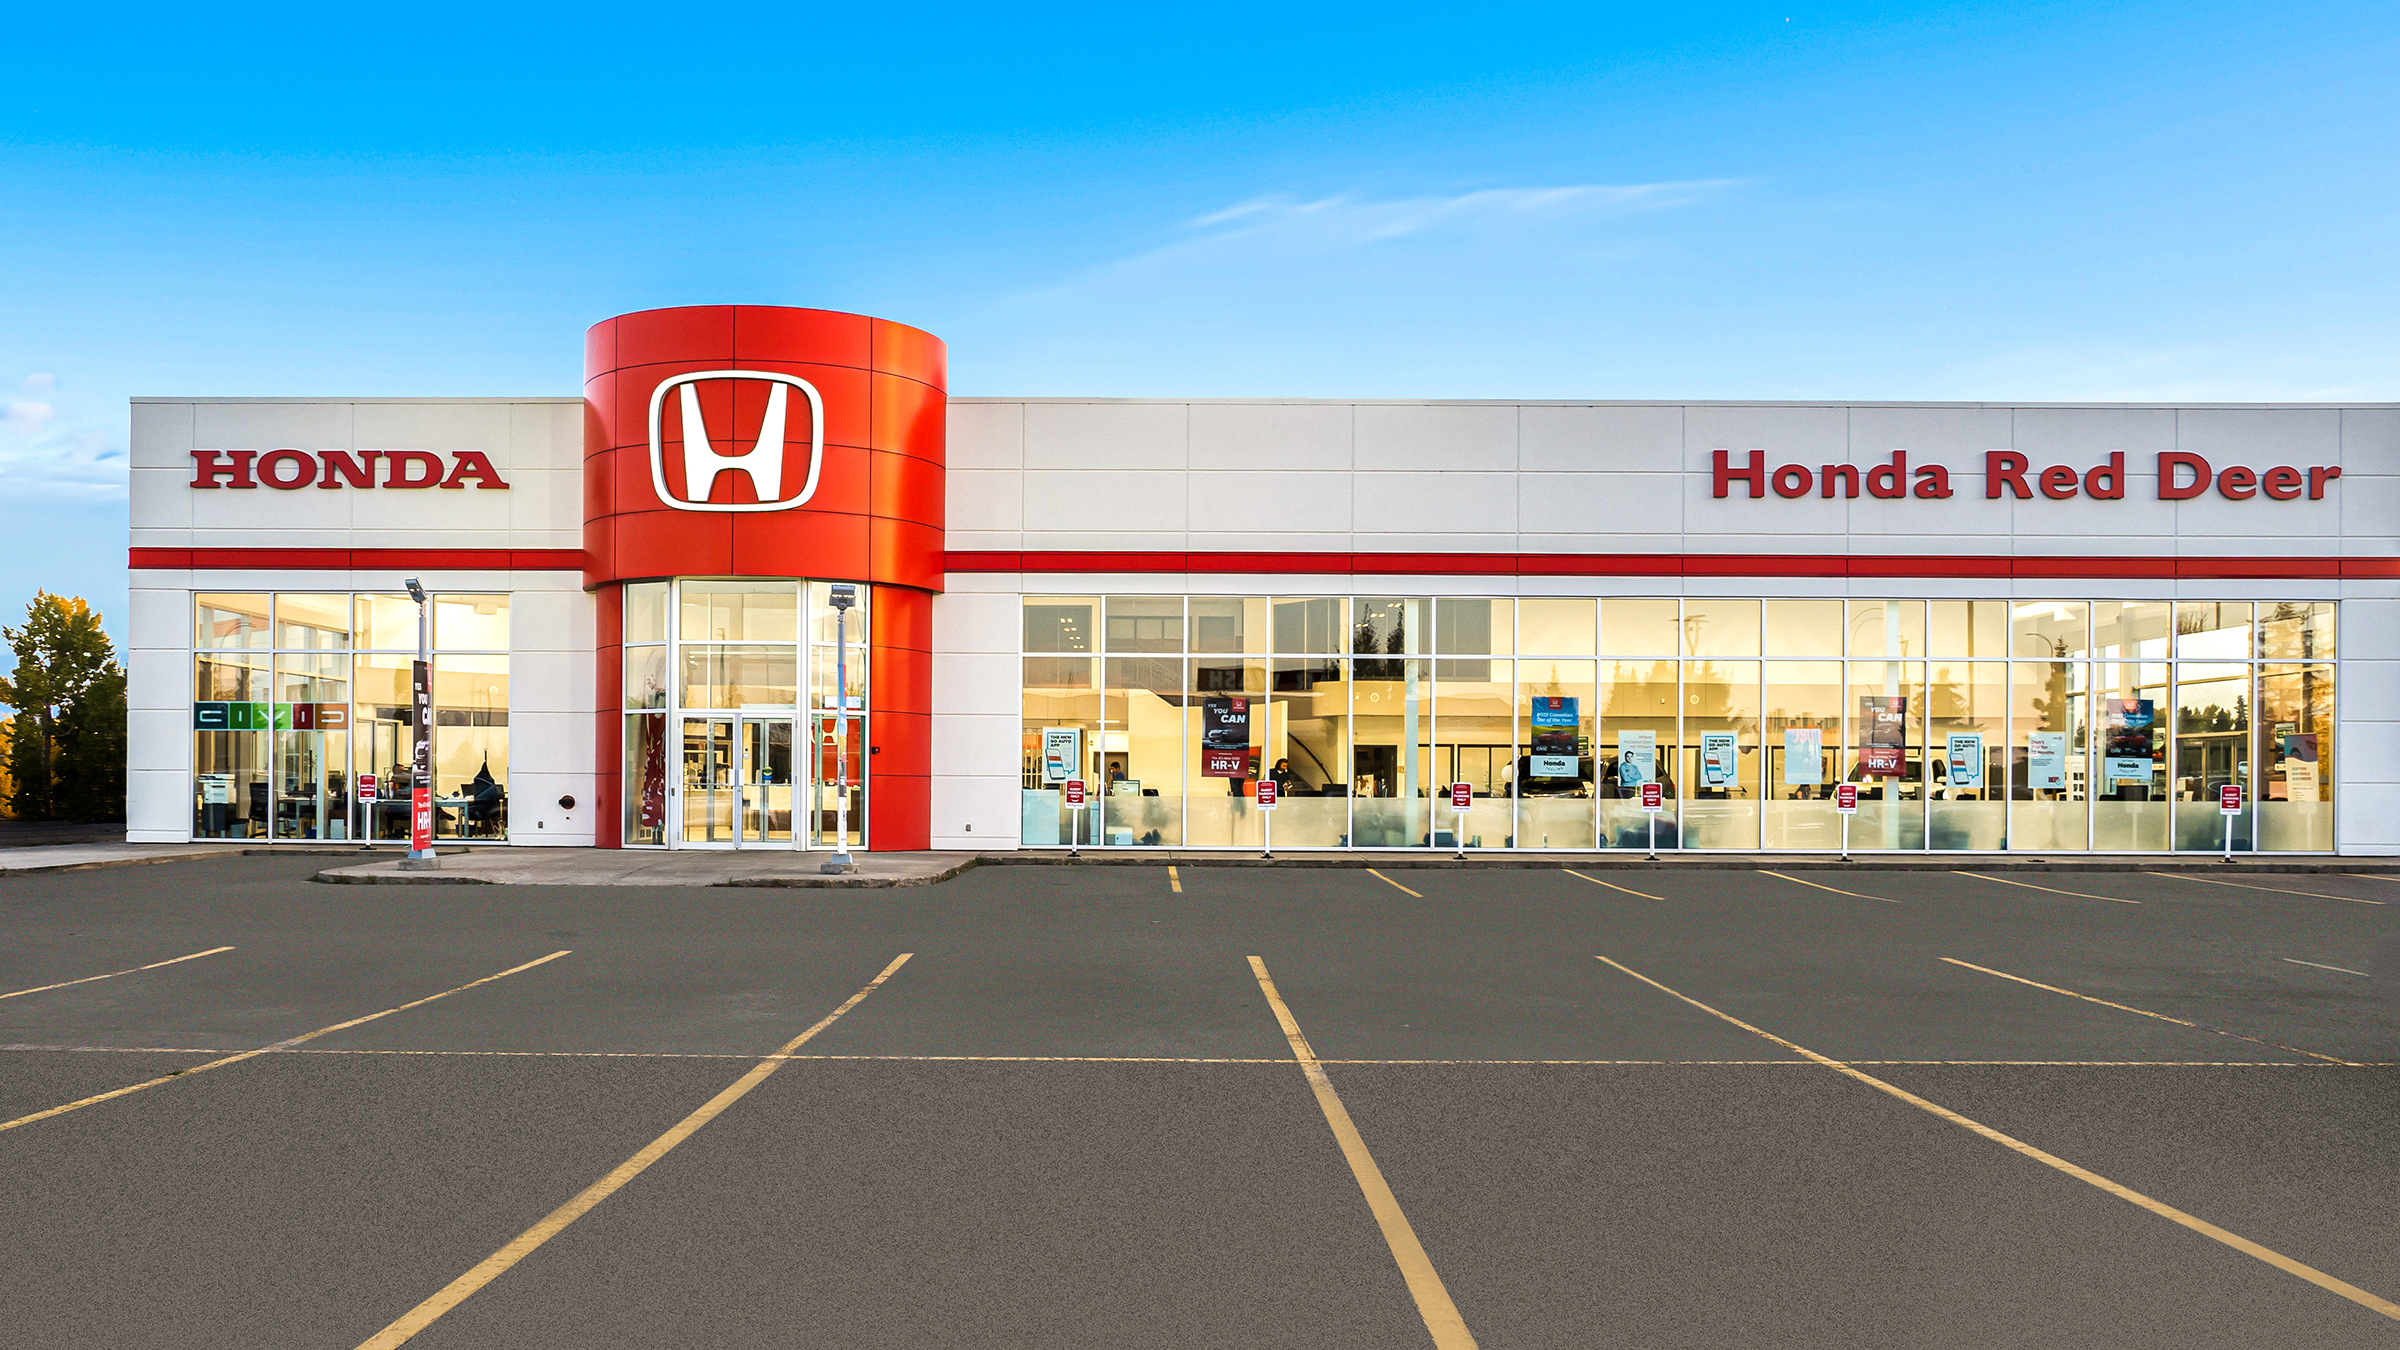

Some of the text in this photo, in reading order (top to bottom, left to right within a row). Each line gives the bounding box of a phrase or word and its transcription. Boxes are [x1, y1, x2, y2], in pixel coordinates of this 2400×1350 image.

[190, 450, 510, 489] HONDA
[1712, 449, 2343, 500] Honda Red Deer
[1221, 714, 1246, 723] CAN
[1878, 713, 1902, 722] CAN
[1211, 760, 1240, 770] HR-V
[1868, 759, 1897, 768] HR-V
